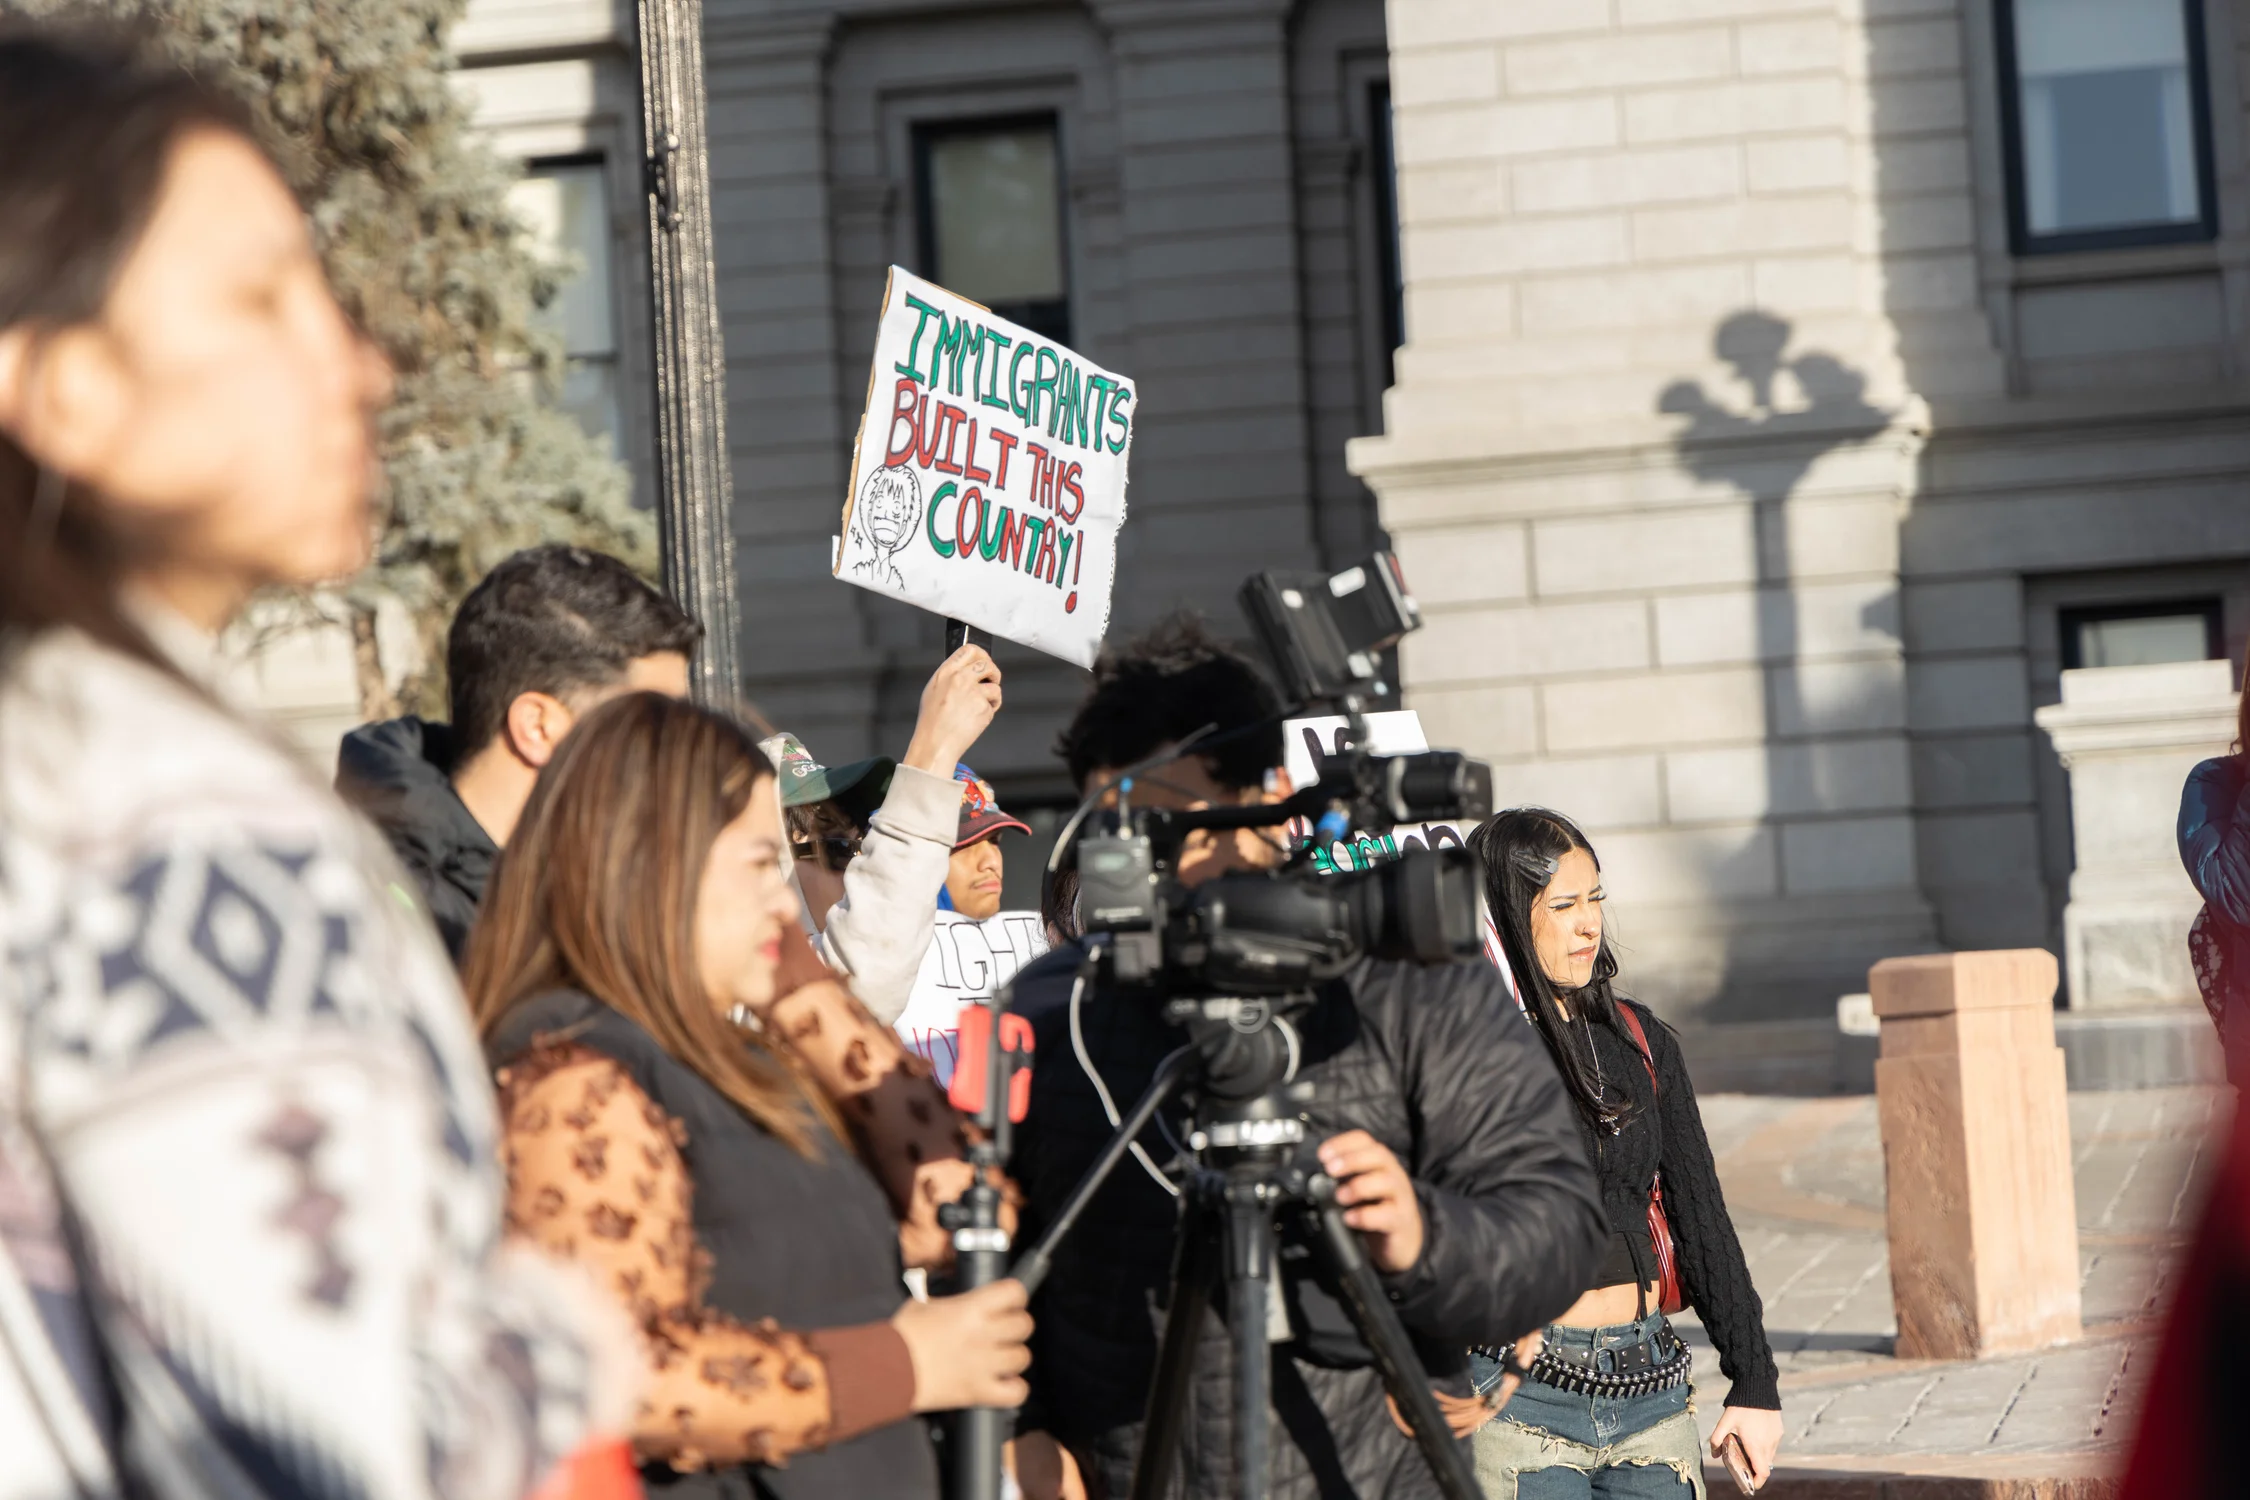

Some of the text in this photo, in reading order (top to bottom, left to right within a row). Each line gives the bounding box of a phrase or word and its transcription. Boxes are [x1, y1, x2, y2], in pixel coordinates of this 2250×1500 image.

[895, 291, 1131, 456] IMMIGRANTS
[885, 379, 1084, 524] BUILT THIS
[927, 481, 1084, 614] COUNTRY!
[934, 916, 1037, 990] IGHT
